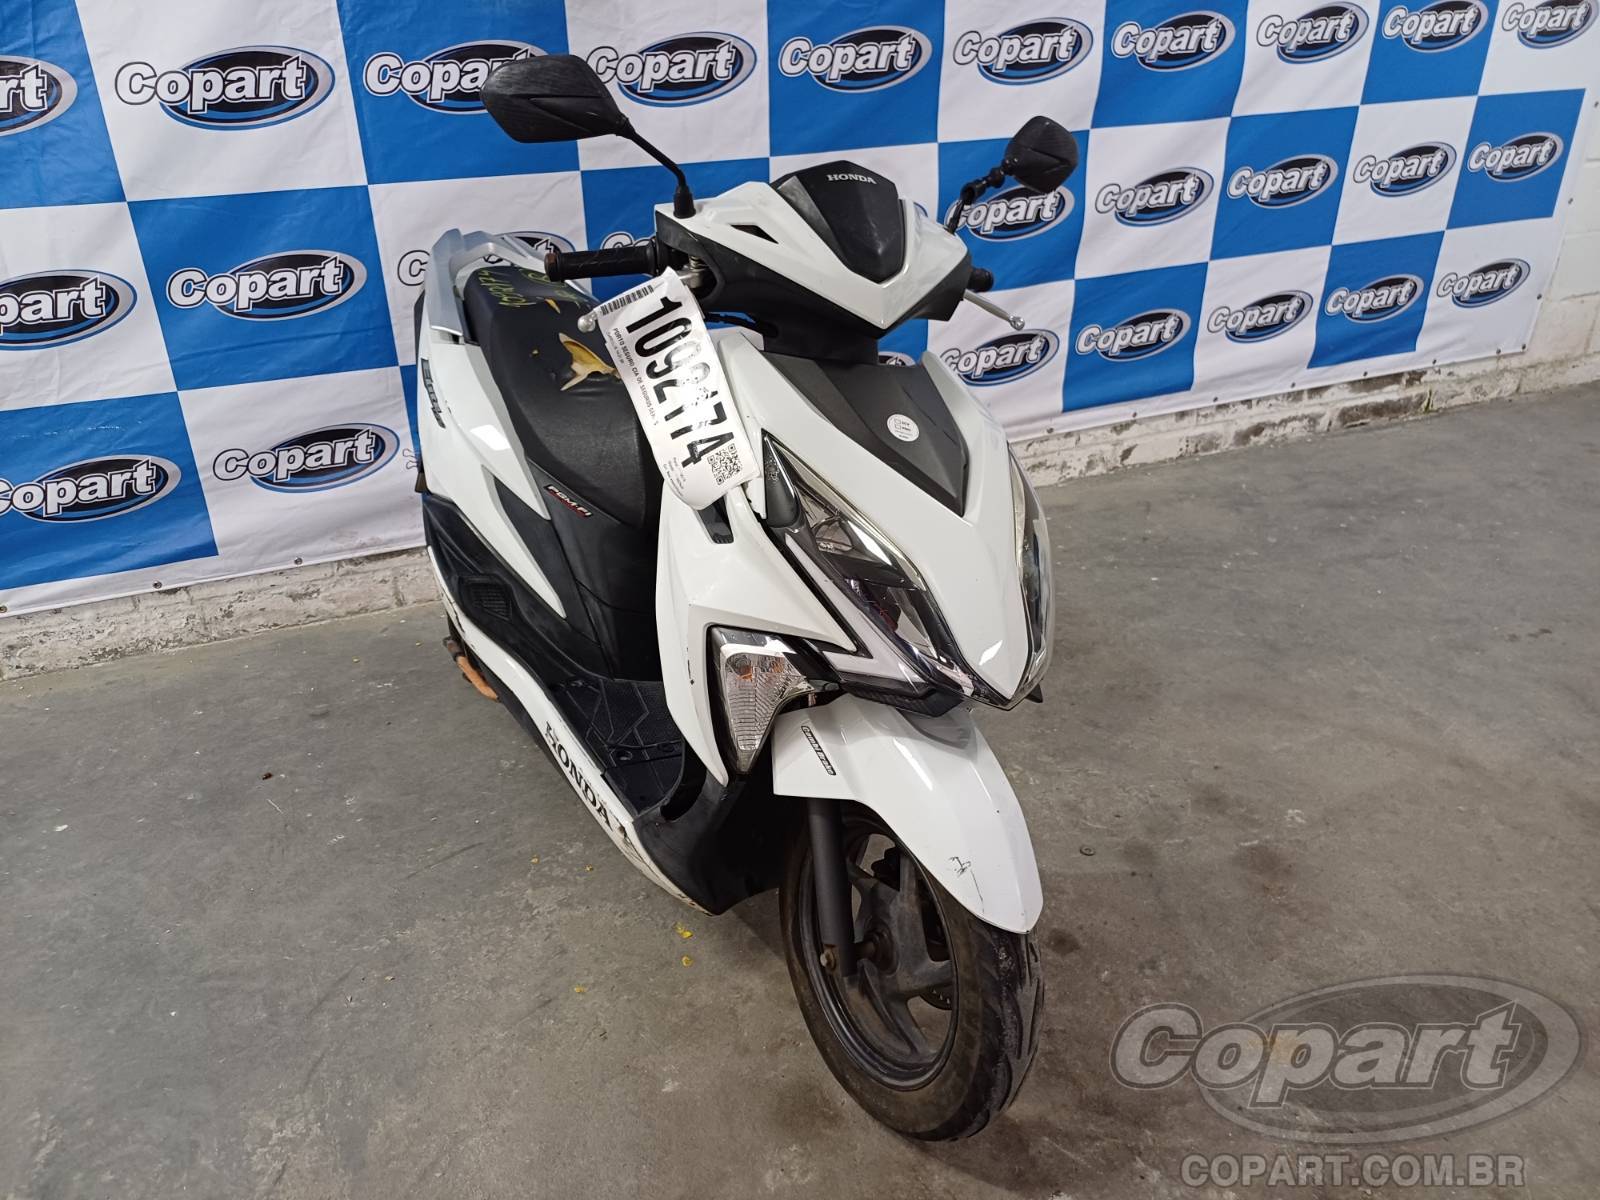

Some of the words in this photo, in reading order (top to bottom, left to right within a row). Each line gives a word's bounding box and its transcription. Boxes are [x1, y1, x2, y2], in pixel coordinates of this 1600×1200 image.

[1256, 9, 1355, 53] Copart
[1381, 3, 1480, 44] Copart
[1501, 0, 1588, 37] Copart
[779, 27, 915, 78] Copart
[953, 26, 1076, 73] Copart
[1111, 18, 1222, 63] Copart
[115, 55, 306, 115] Copart
[363, 47, 530, 103] Copa
[587, 40, 737, 92] Copart
[1353, 148, 1445, 184] Copart
[1469, 136, 1557, 173] Copart
[826, 173, 877, 184] HONDA
[1095, 175, 1200, 215] Copart
[1226, 159, 1328, 200] Copart
[167, 254, 344, 312] Copart
[1324, 278, 1414, 318] Copart
[1436, 261, 1522, 299] Copart
[0, 275, 106, 335] part
[1207, 295, 1303, 335] Copart
[1076, 313, 1178, 356] Copart
[213, 429, 377, 480] Copart
[545, 721, 613, 831] HONDA
